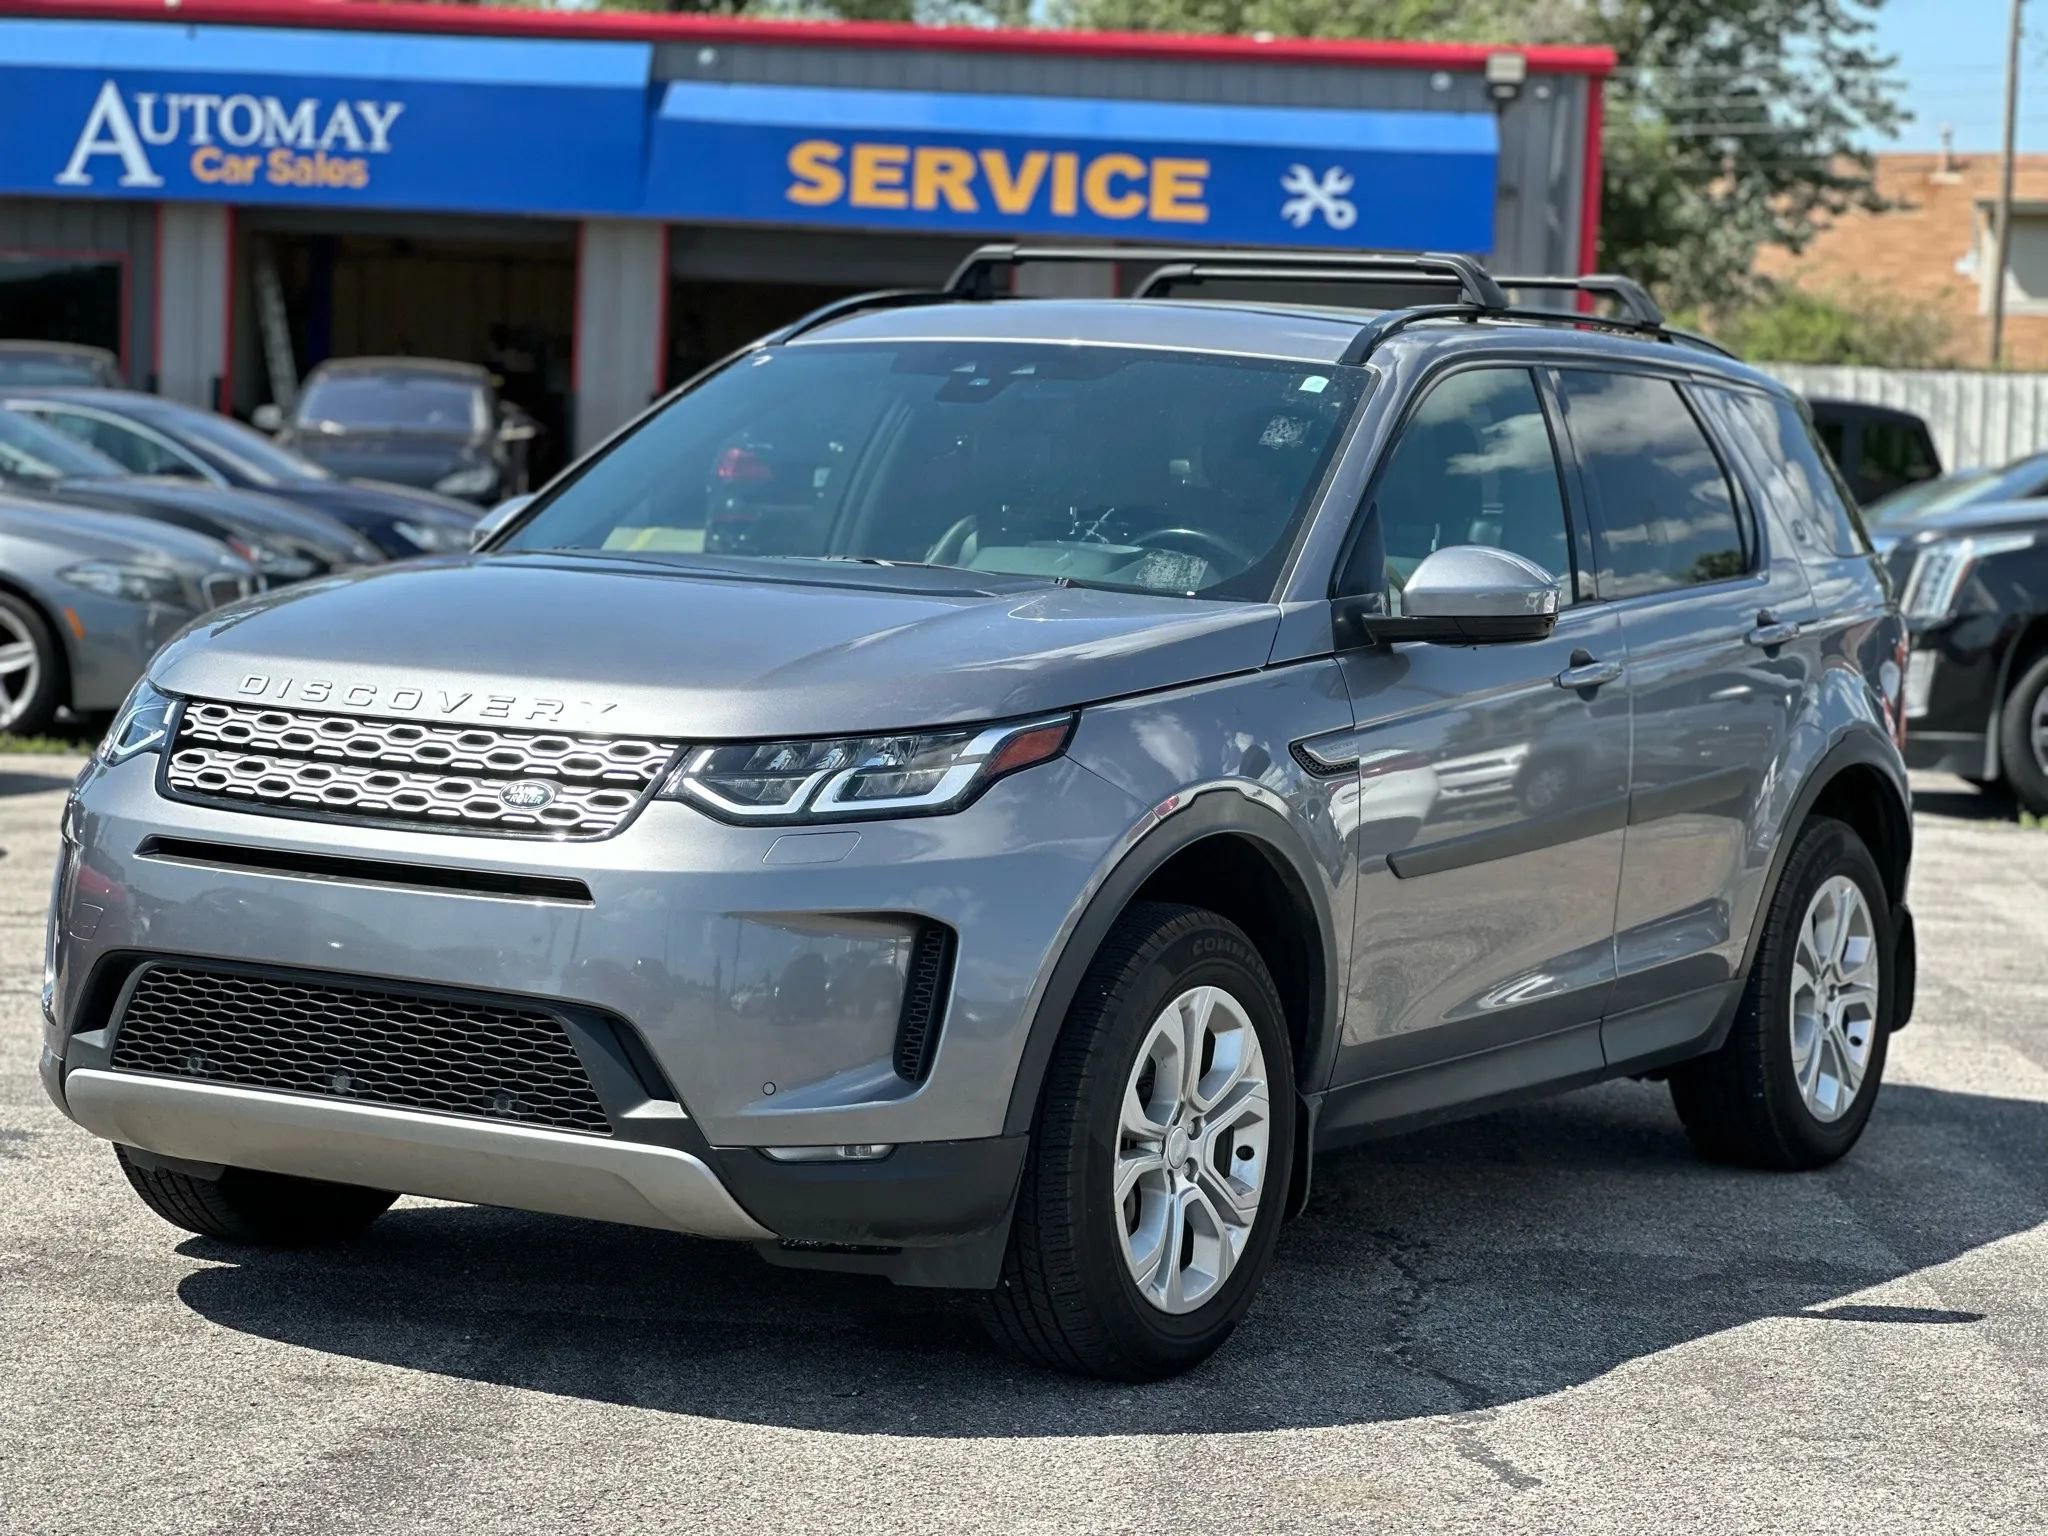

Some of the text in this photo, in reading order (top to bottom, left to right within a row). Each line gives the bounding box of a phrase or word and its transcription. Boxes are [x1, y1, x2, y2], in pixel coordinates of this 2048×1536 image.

[54, 79, 404, 187] AUTOMAY
[191, 146, 369, 189] Car Sales
[786, 140, 1210, 223] SERVICE
[238, 673, 618, 724] DISCOVERY
